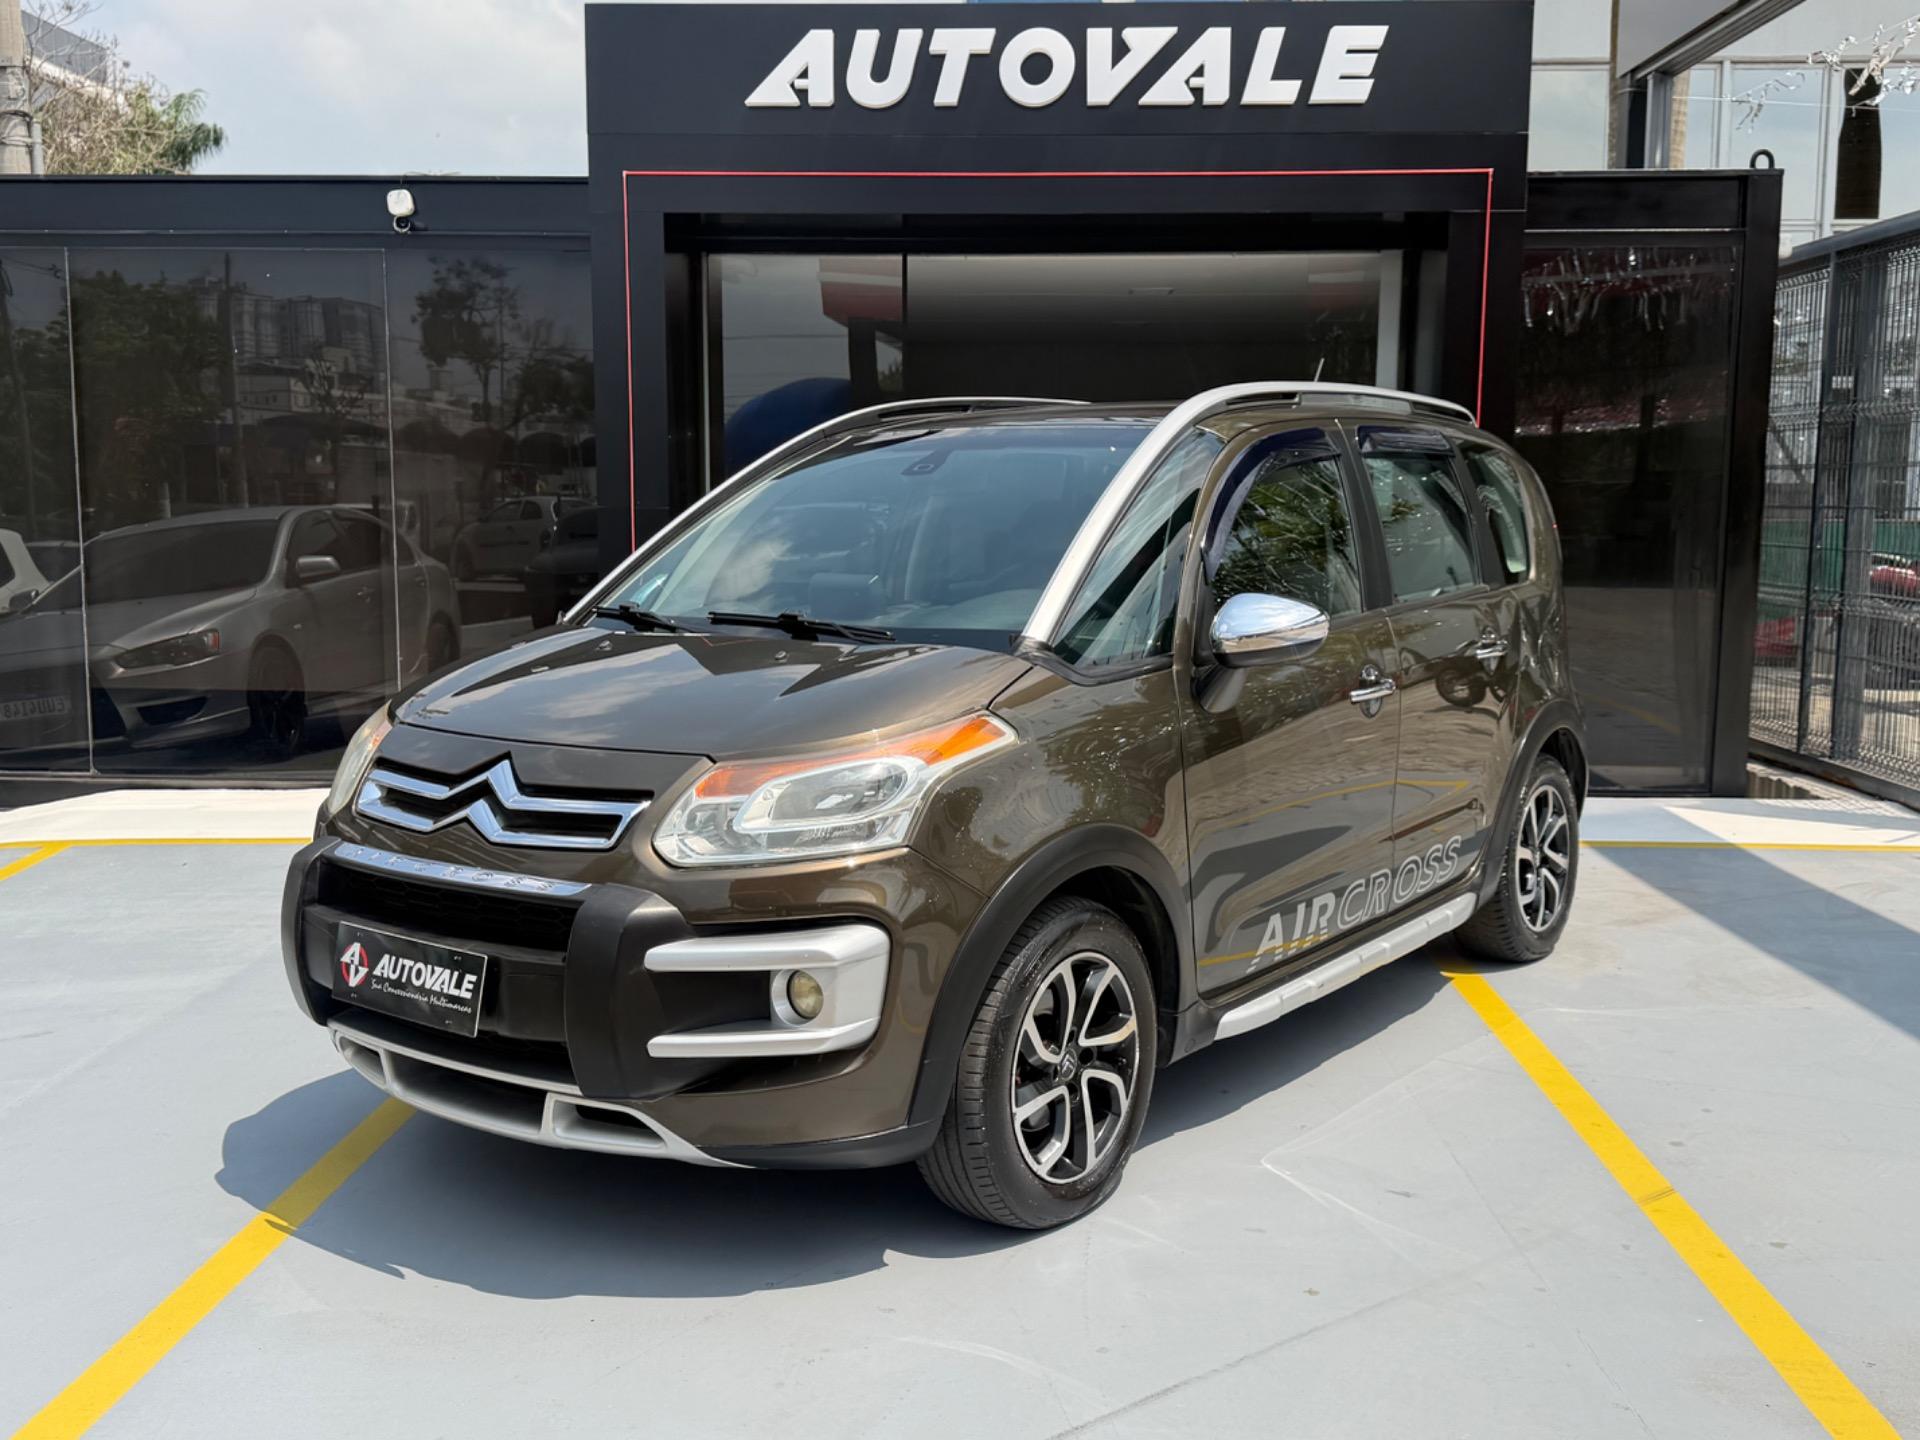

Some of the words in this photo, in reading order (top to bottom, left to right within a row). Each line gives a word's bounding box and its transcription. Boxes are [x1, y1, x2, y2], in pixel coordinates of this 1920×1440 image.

[745, 25, 1389, 108] AUTOVALE
[1246, 835, 1462, 974] AIRCROSS
[373, 953, 478, 999] AUTOVALE
[429, 994, 473, 1014] Multimarcas
